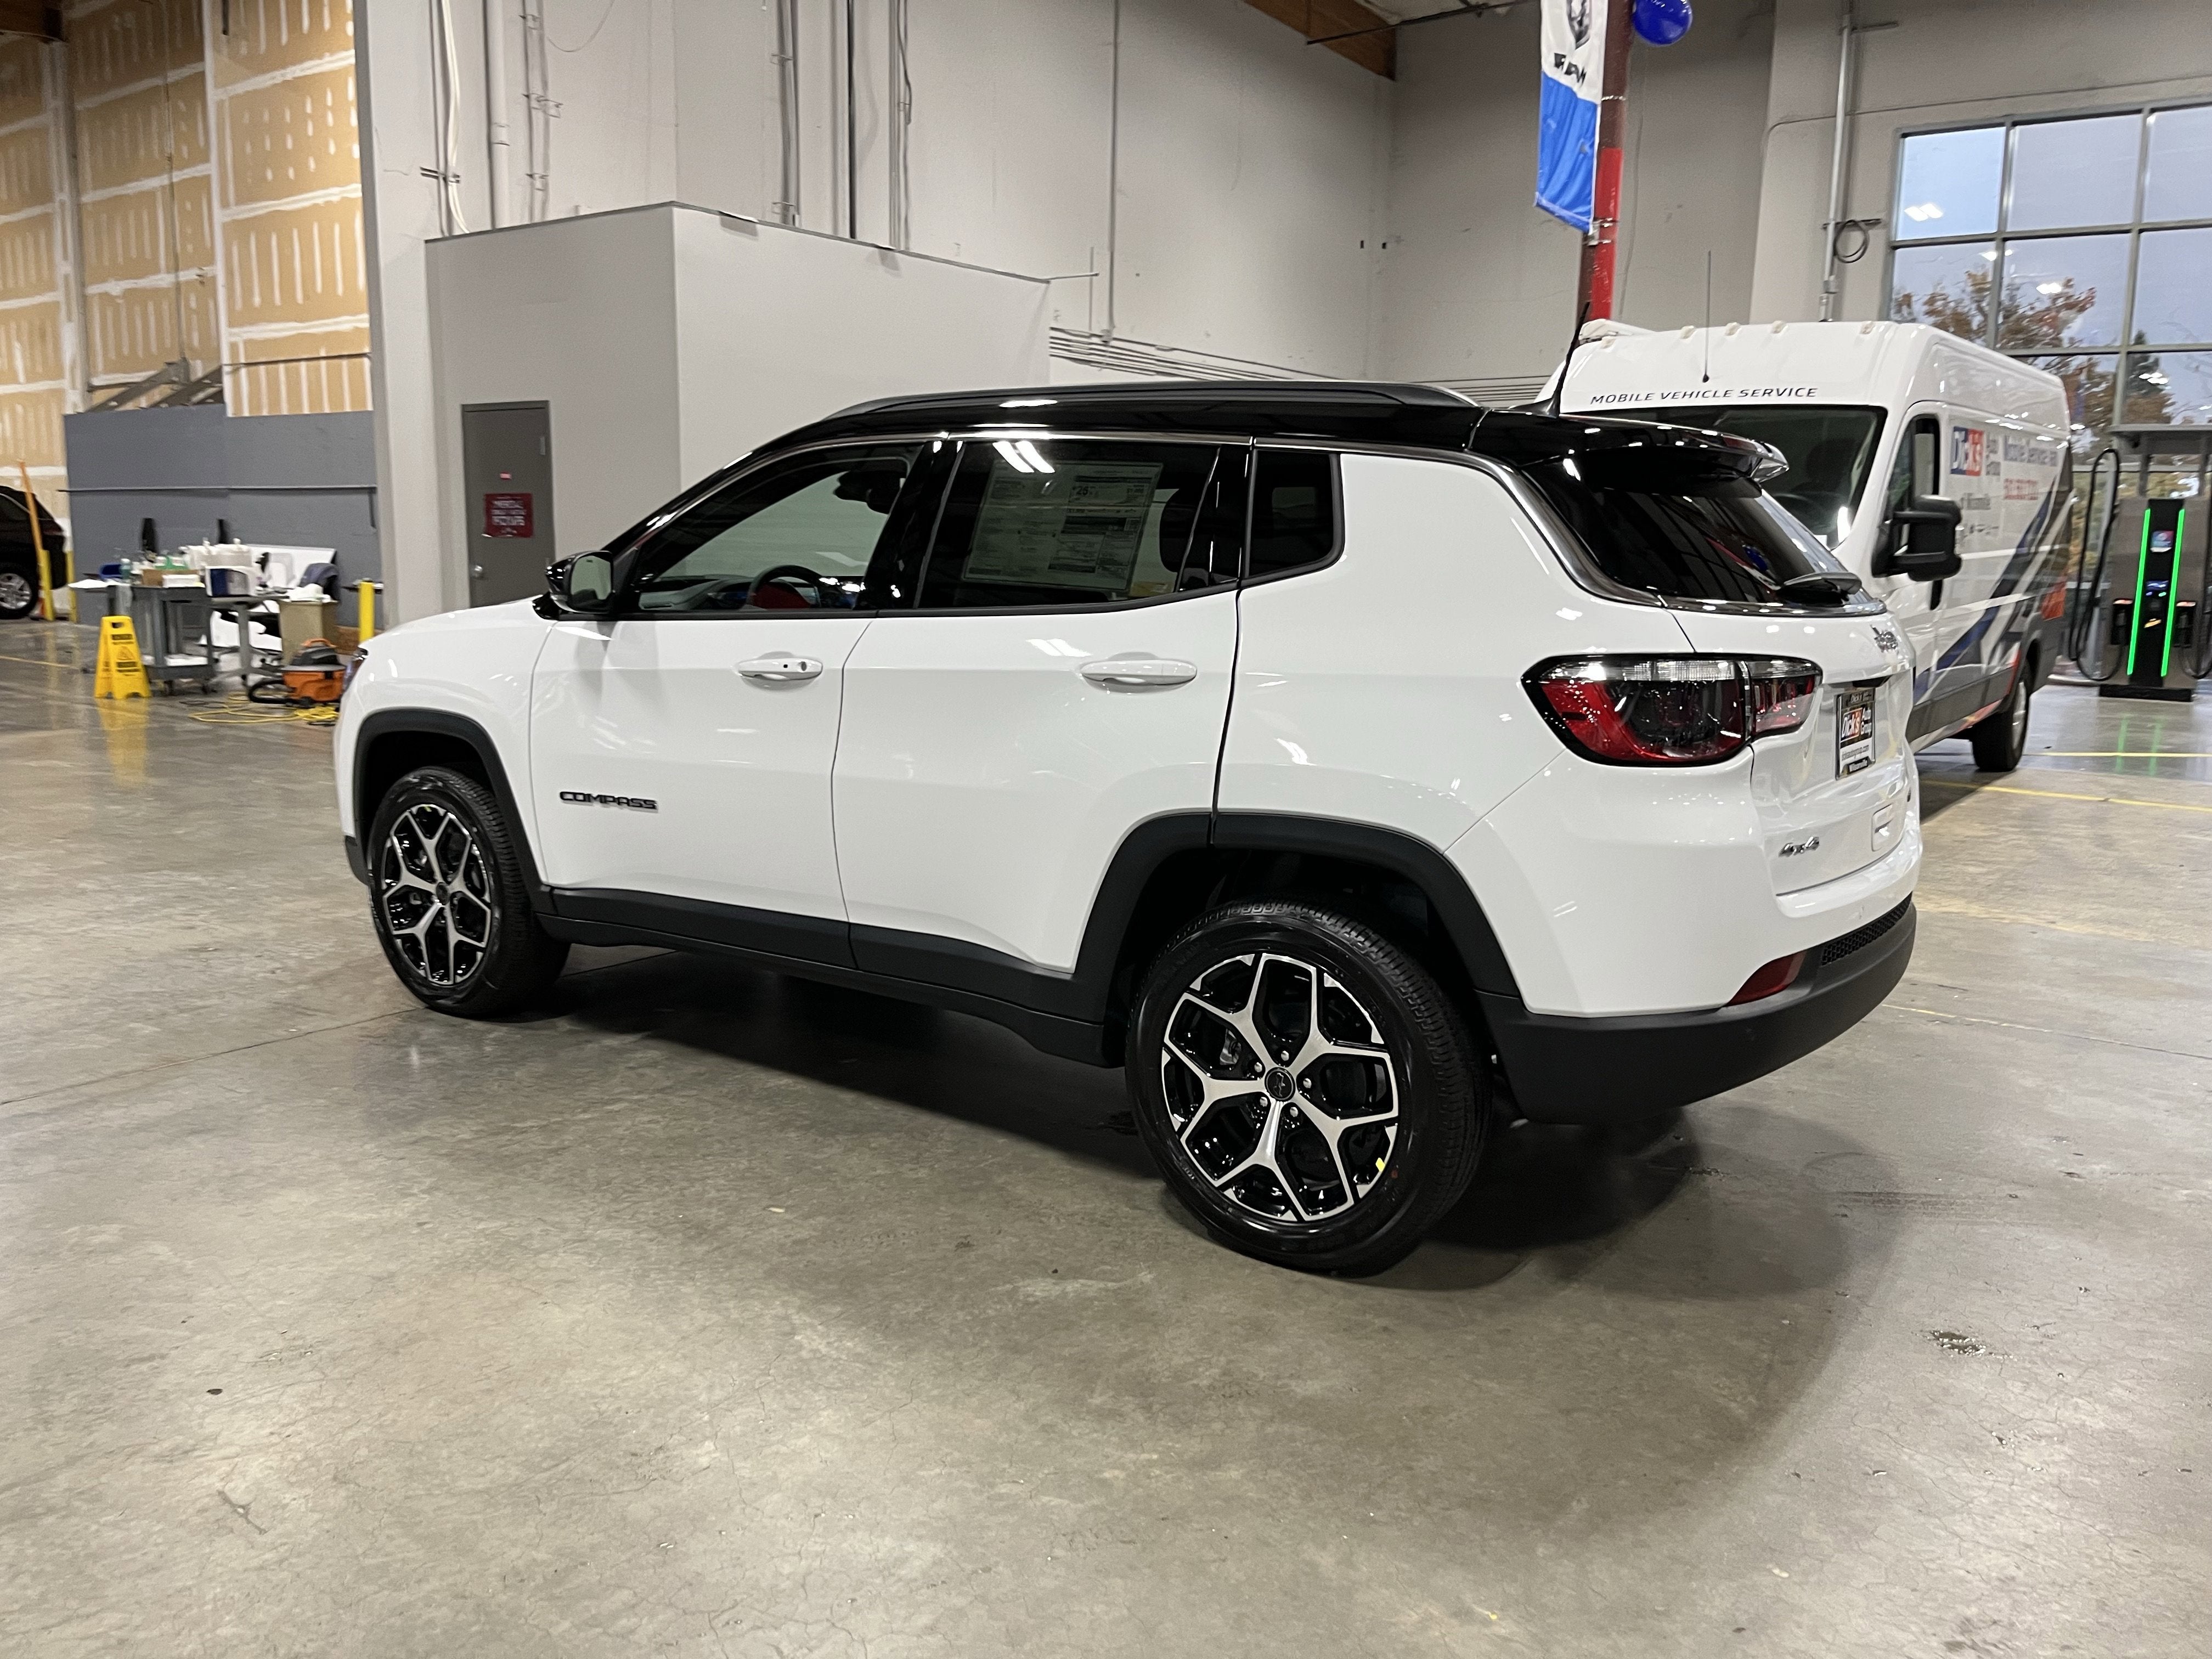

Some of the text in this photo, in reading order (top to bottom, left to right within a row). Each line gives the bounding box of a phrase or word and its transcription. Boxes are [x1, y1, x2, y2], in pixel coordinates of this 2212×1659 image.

[1590, 387, 1818, 405] MOBILE VEHICLE SERVICE
[560, 791, 657, 810] COMPASS
